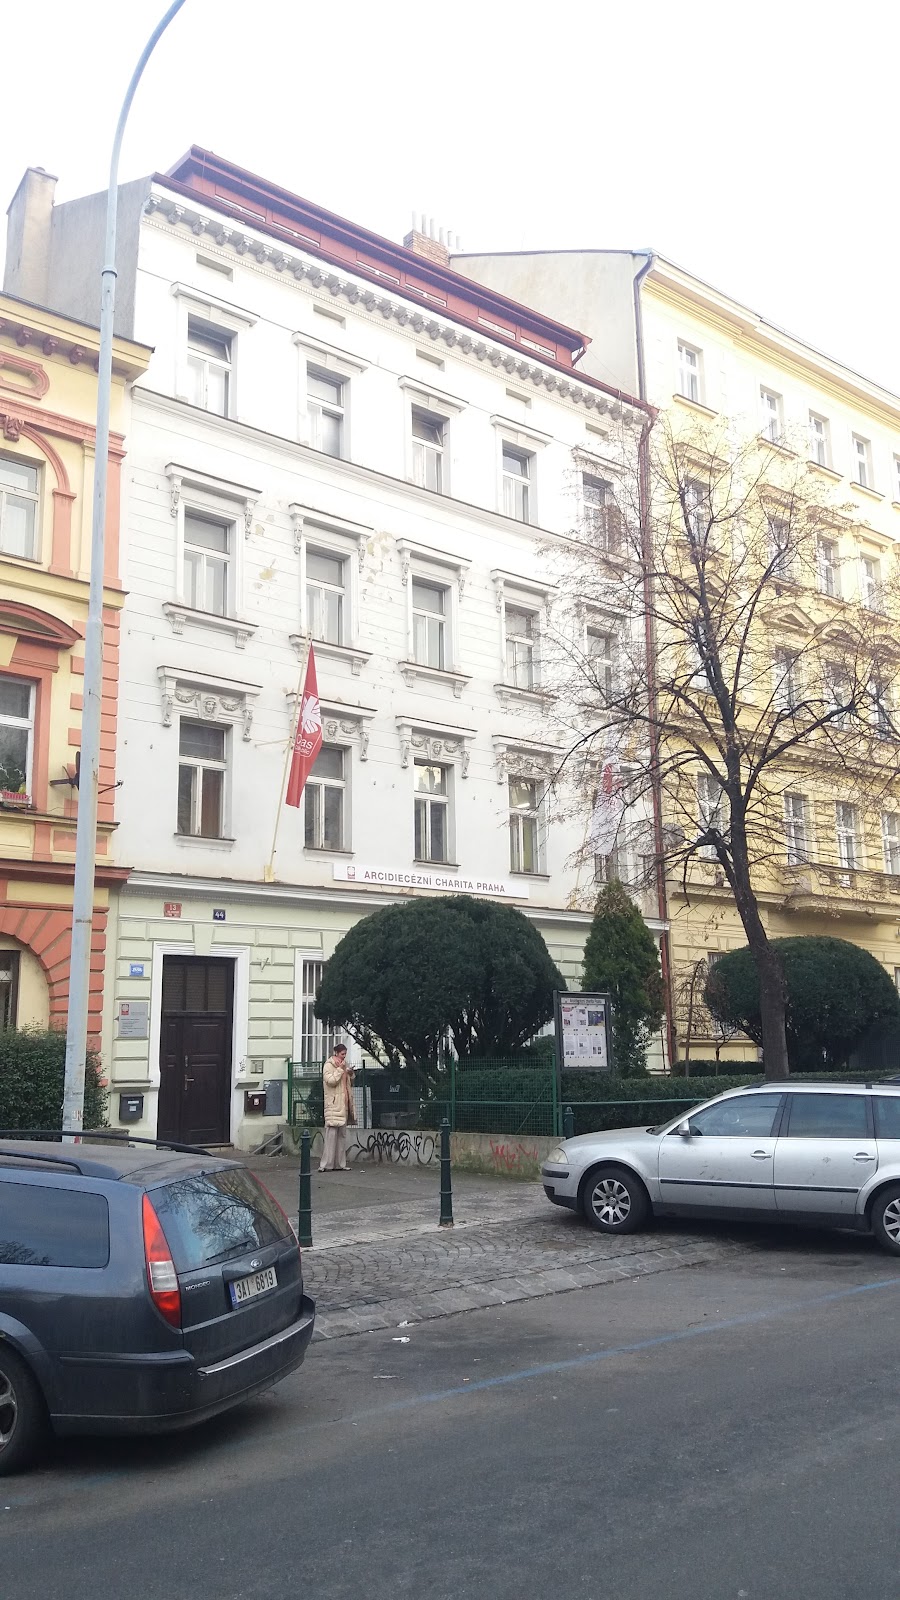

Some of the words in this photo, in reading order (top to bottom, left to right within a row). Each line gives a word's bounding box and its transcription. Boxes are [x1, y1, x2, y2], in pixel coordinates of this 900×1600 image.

[364, 871, 432, 885] ARCIDIECÉZNÍ
[435, 878, 474, 889] CHARITA
[476, 882, 505, 892] PRAHA
[214, 911, 224, 919] 44
[255, 1270, 274, 1291] 6819
